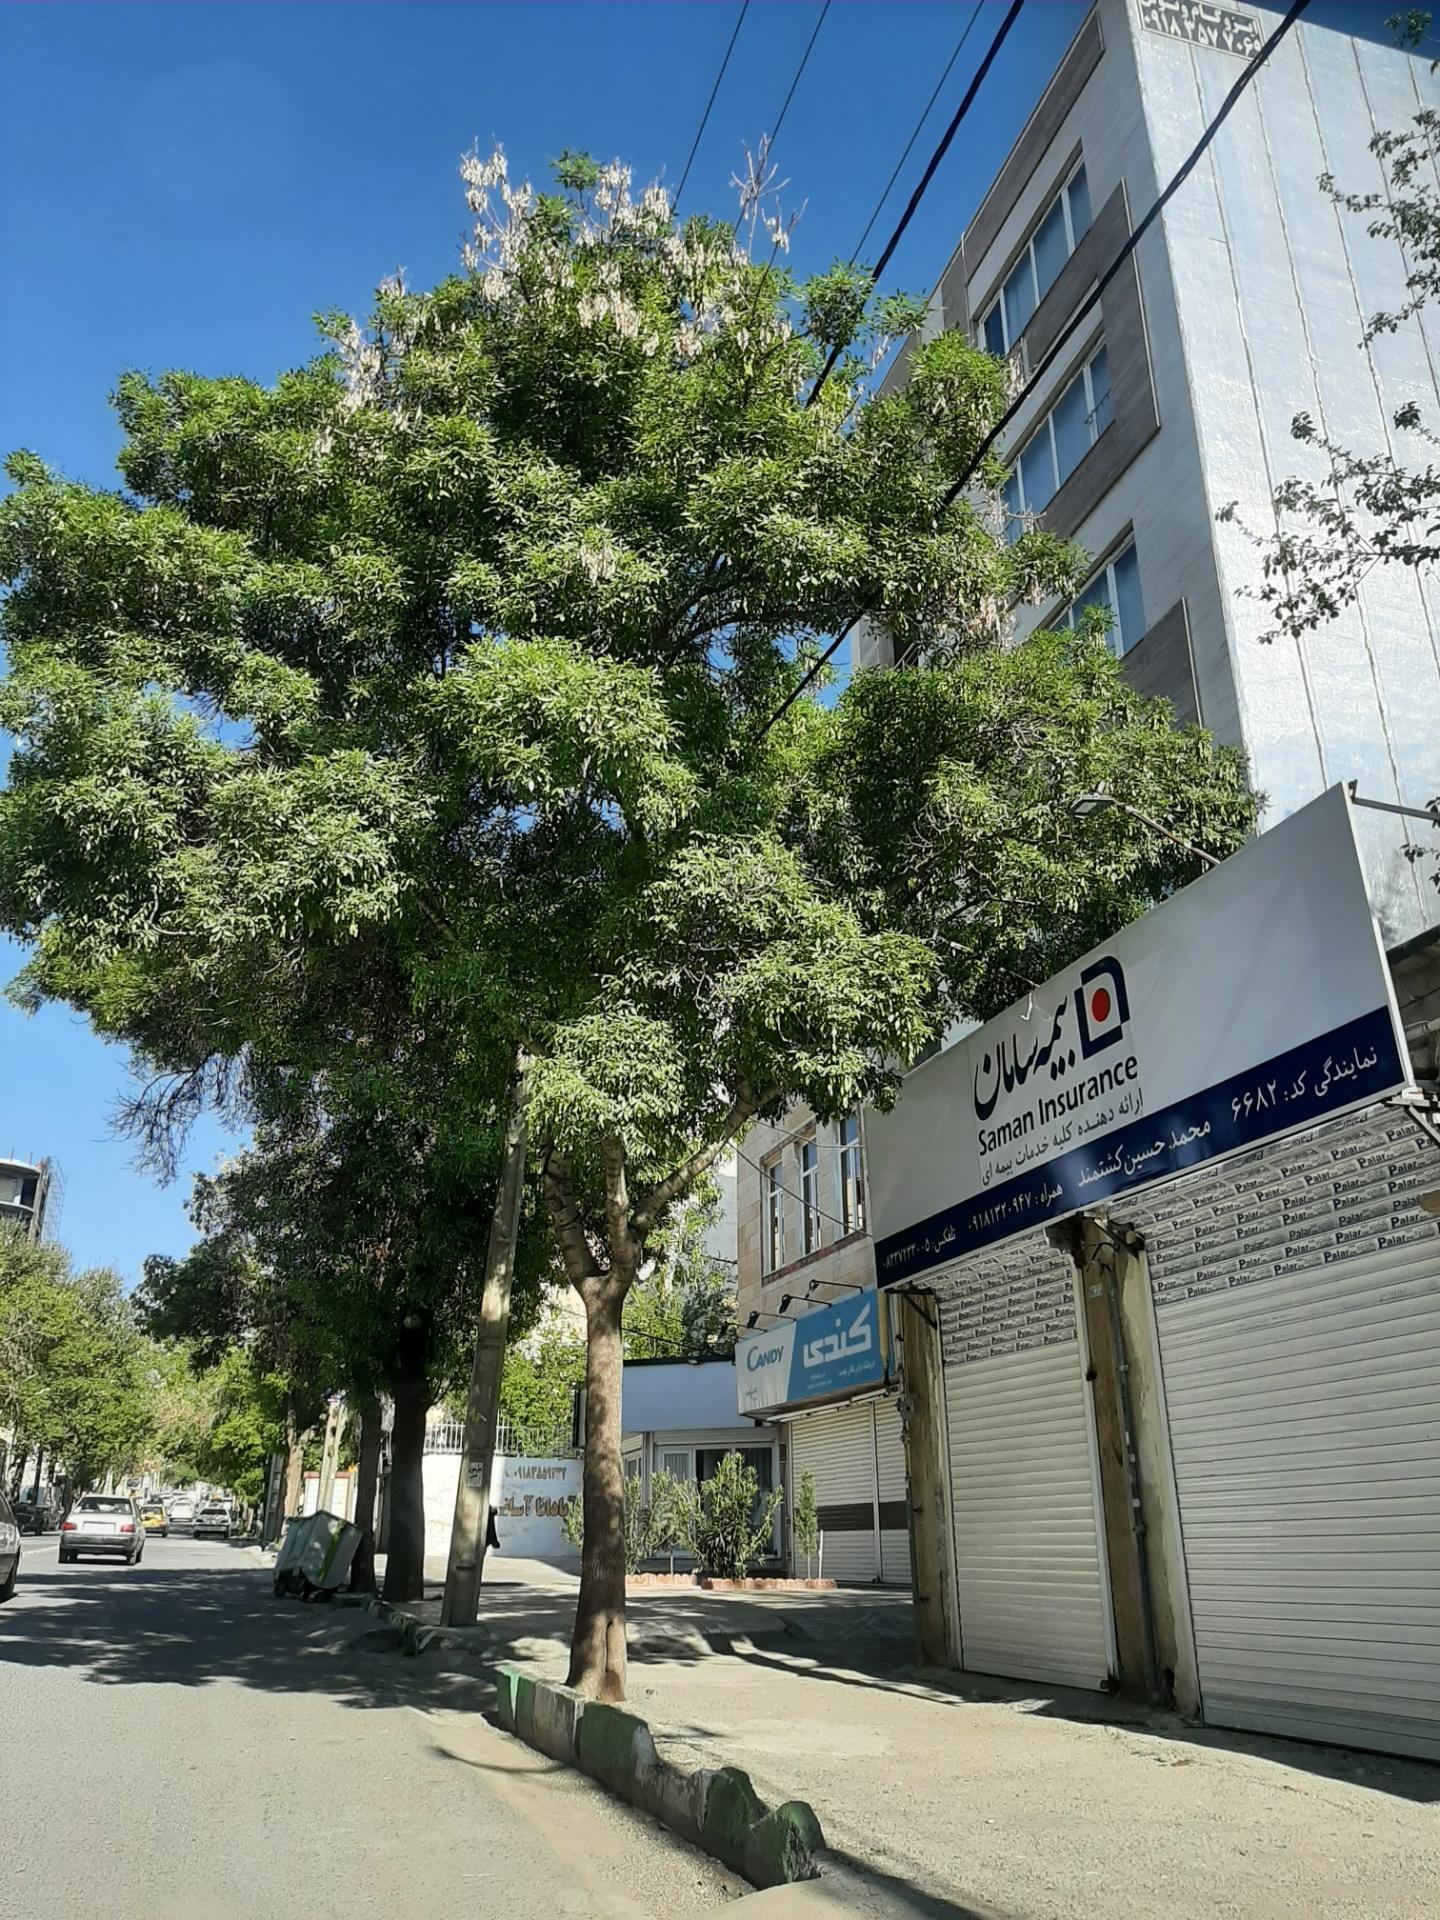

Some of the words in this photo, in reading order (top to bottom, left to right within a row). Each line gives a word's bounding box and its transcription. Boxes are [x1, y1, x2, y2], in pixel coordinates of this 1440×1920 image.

[1033, 995, 1076, 1081] بیمه
[974, 1033, 1038, 1121] سامان
[1314, 1046, 1378, 1097] نمایندگی
[978, 1110, 1034, 1156] Saman
[1038, 1055, 1138, 1125] Insurance
[1118, 1087, 1144, 1115] ارائه
[1231, 1079, 1277, 1123] ۶۶۸۲
[1052, 1121, 1073, 1149] کلیه
[1077, 1107, 1115, 1136] دهنده
[1169, 1120, 1211, 1149] محمد
[995, 1159, 1013, 1176] بیمه
[1015, 1136, 1049, 1165] خدمات
[1078, 1143, 1124, 1187] کشتمند
[1124, 1139, 1166, 1175] حسین
[982, 1161, 993, 1186] ای
[803, 1301, 872, 1368] کندی
